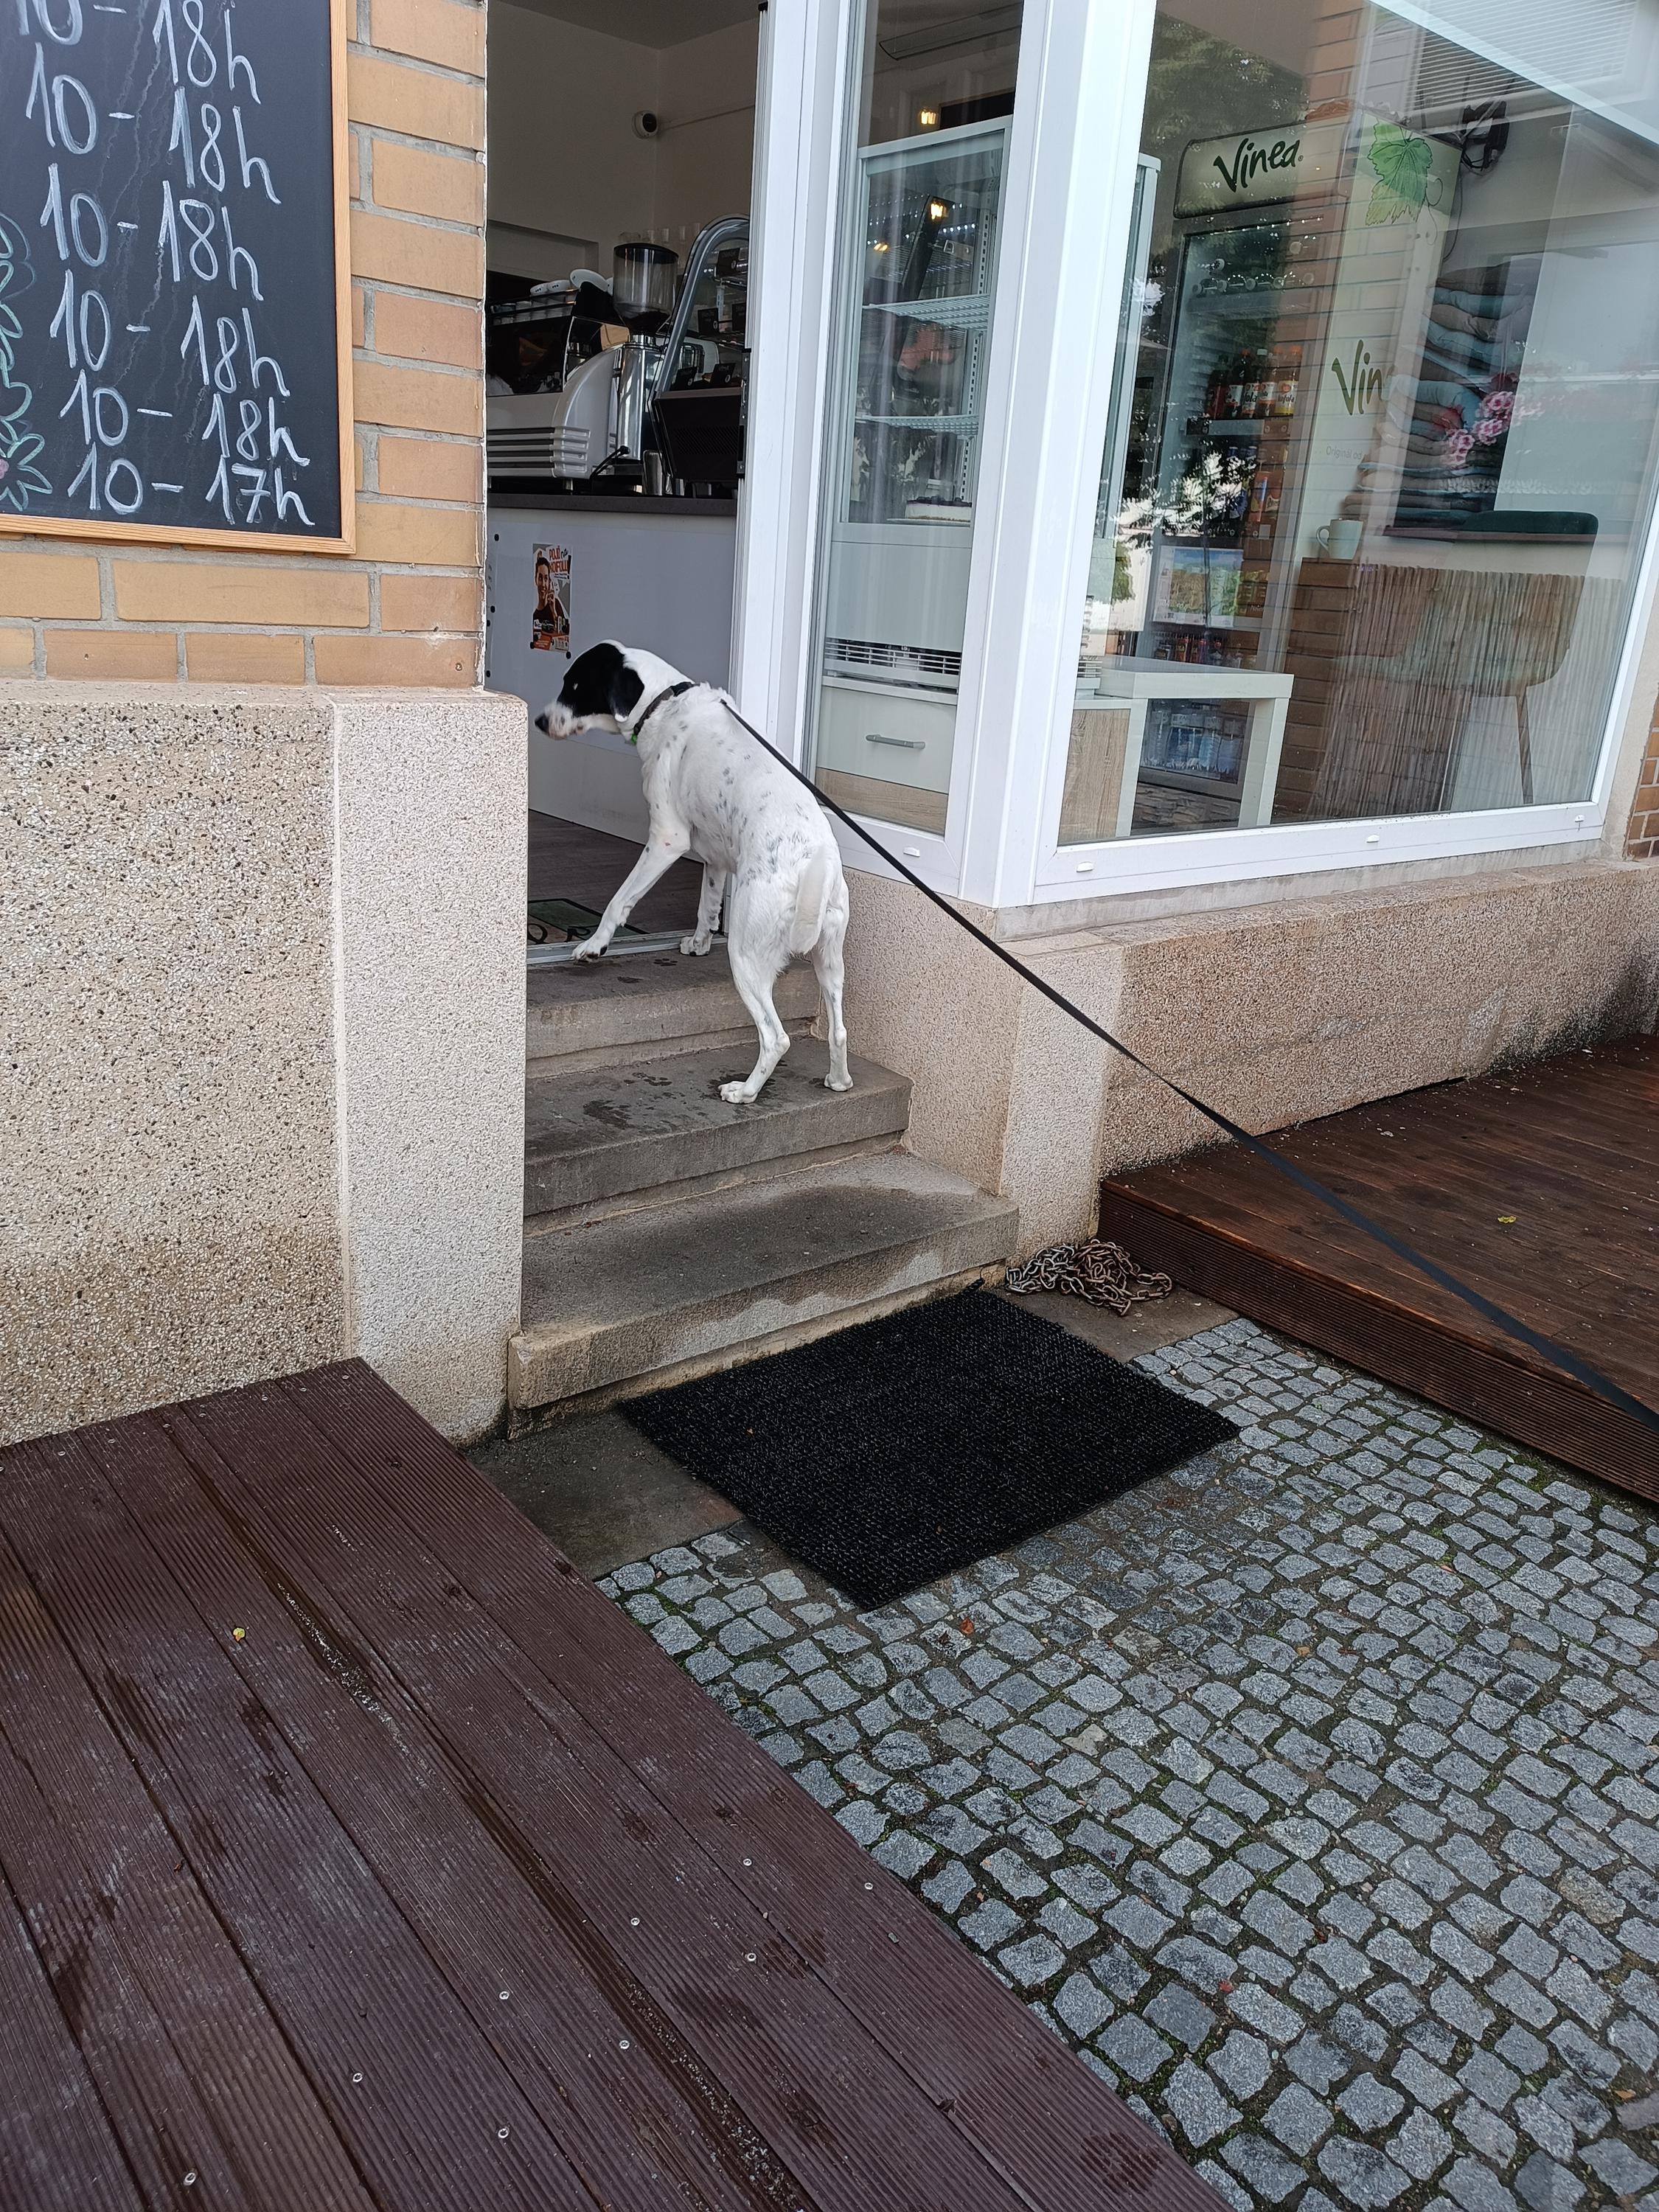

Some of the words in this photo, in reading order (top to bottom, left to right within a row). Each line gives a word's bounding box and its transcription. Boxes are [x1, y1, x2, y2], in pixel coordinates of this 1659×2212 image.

[152, 0, 262, 105] 18h
[169, 86, 282, 205] 18h
[1213, 138, 1300, 192] Vinea
[158, 181, 264, 302] 18h
[181, 295, 291, 397] 18h
[1332, 339, 1383, 416] Vin
[202, 392, 310, 467] 18h
[206, 456, 316, 526] 17h
